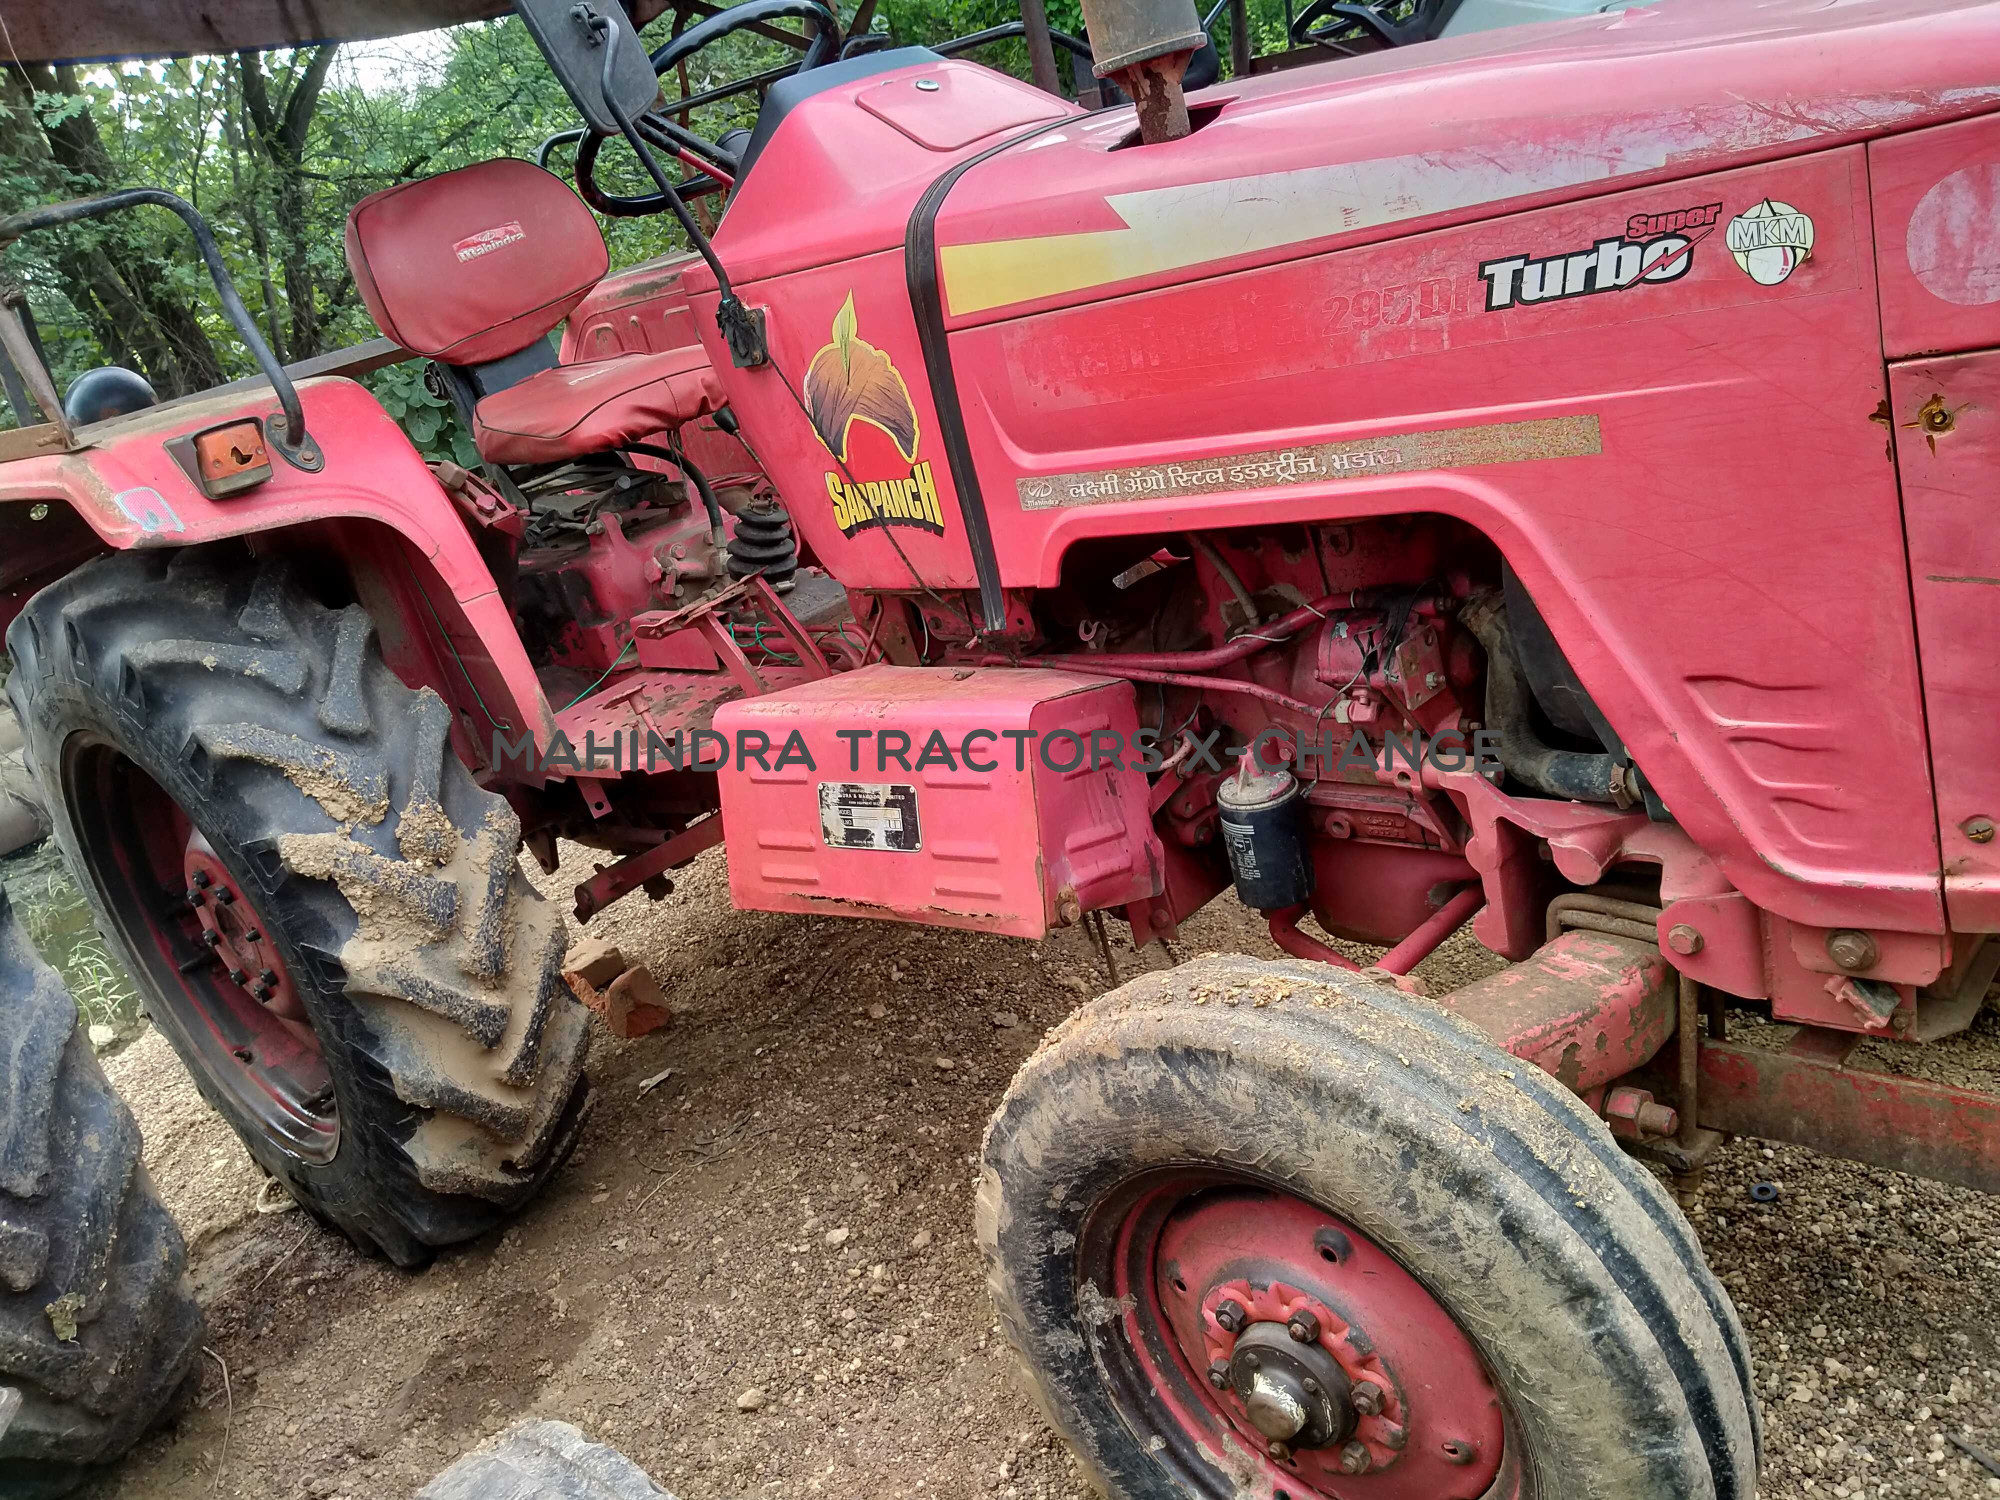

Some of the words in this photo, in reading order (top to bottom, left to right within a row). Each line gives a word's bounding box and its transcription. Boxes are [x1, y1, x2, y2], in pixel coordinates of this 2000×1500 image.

[1627, 202, 1723, 238] Super
[1732, 216, 1808, 250] MKM
[1479, 231, 1698, 312] Turbo
[824, 460, 945, 540] SARPANCH
